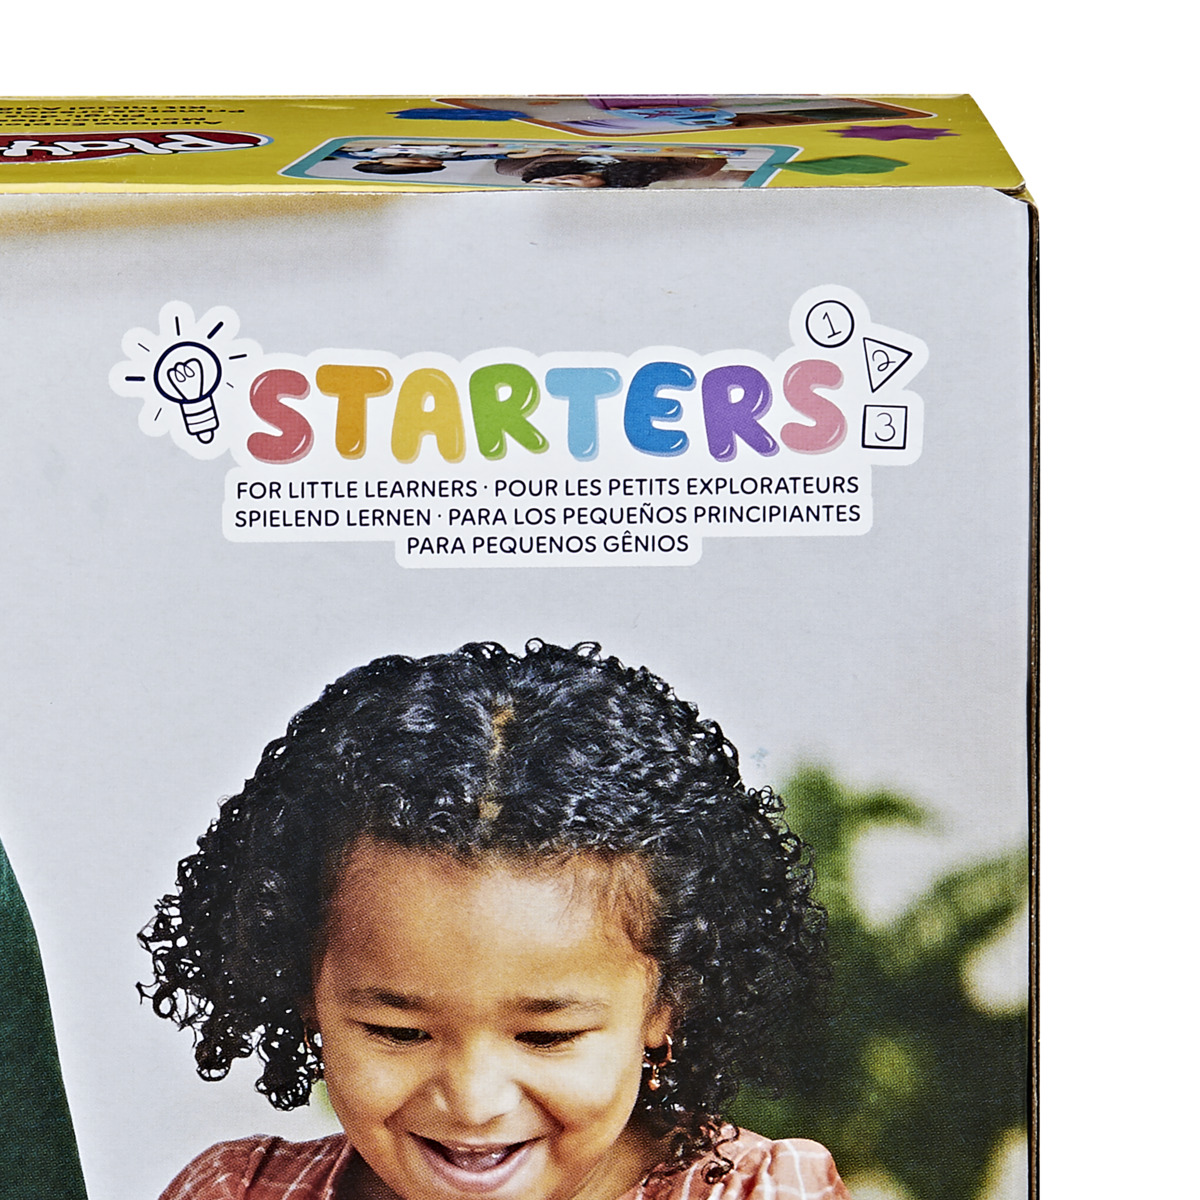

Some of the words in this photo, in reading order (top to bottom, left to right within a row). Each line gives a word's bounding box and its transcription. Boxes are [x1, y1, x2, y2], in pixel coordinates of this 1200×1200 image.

[822, 311, 842, 339] 1
[246, 360, 847, 464] STARTERS
[874, 412, 896, 442] 3
[237, 482, 281, 499] FOR
[289, 481, 358, 498] LITTLE
[365, 480, 477, 498] LEARNERS
[495, 479, 558, 497] POUR
[565, 479, 601, 496] LES
[609, 478, 679, 496] PETITS
[687, 476, 858, 495] EXPLORATEURS
[235, 510, 339, 527] SPIELEND
[347, 509, 430, 526] LERNEN
[449, 508, 507, 526] PARA
[515, 508, 556, 525] LOS
[563, 503, 687, 525] PEQUEÑOS
[694, 505, 860, 523] PRINCIPIANTES
[408, 537, 466, 554] PARA
[473, 536, 596, 554] PEQUENOS
[603, 530, 688, 552] GÊNIOS
